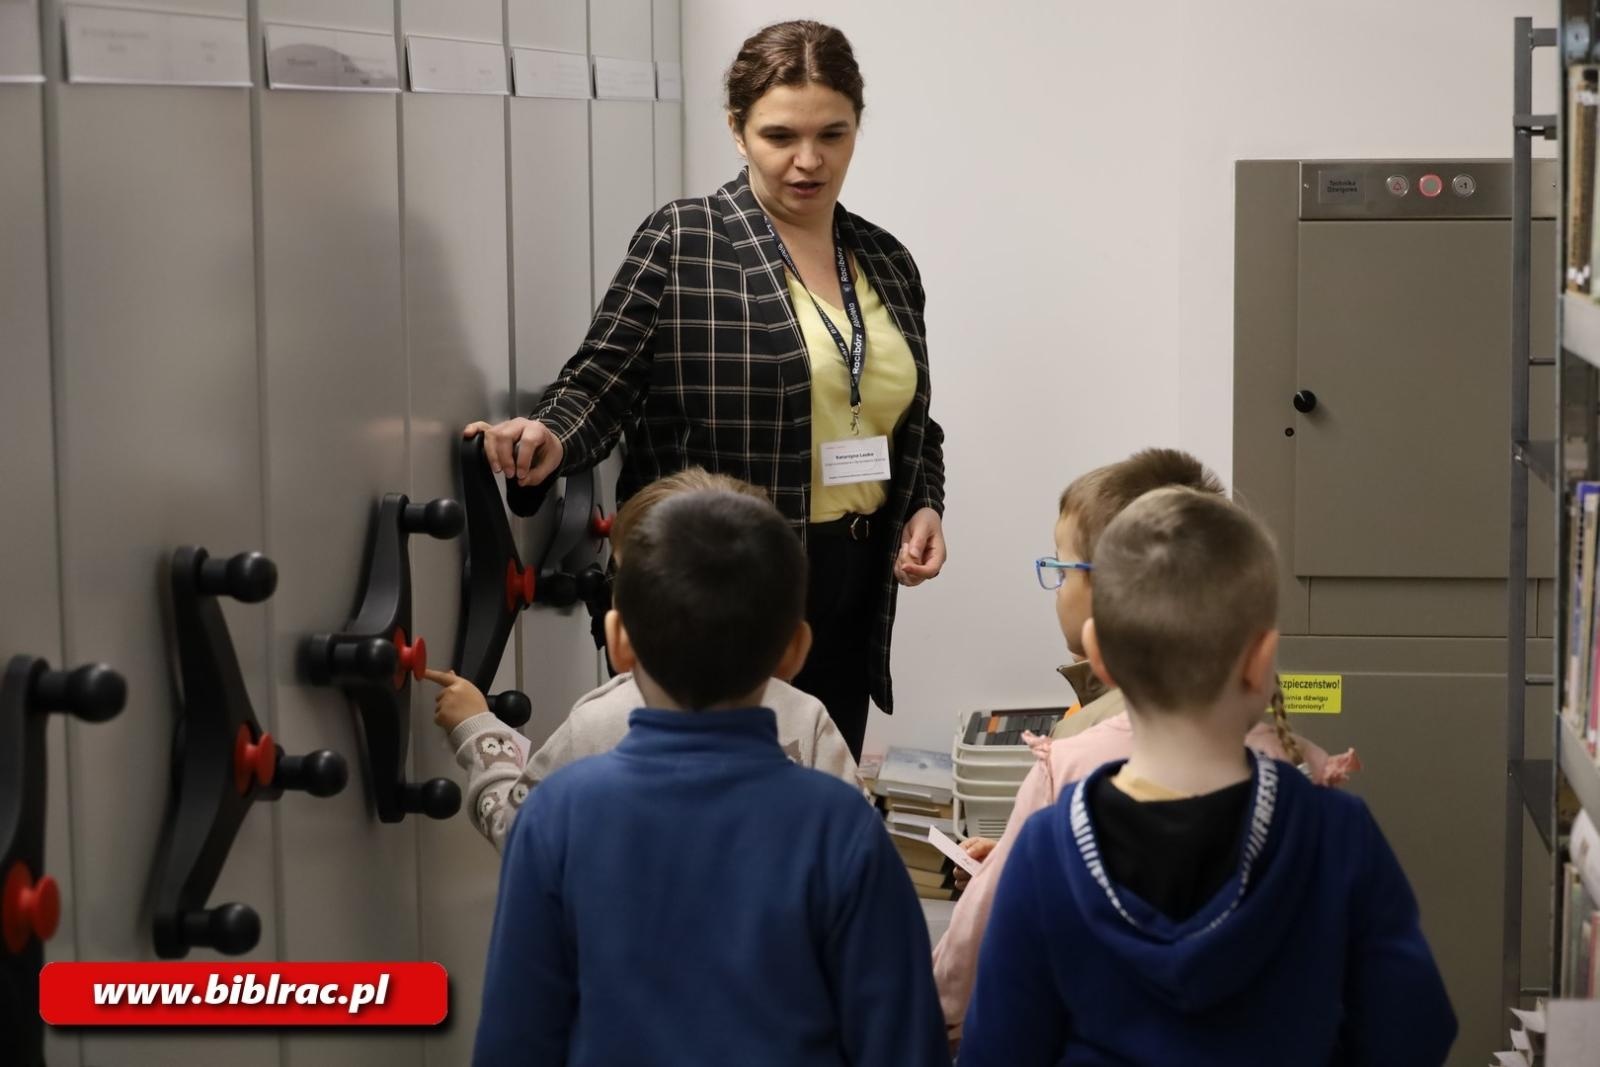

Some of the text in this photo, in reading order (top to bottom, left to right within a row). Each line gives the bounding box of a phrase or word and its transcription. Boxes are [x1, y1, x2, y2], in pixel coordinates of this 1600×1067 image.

[836, 246, 849, 283] Racibórz
[851, 334, 863, 375] Racibórz
[1279, 677, 1340, 691] ezpieczeństwo!
